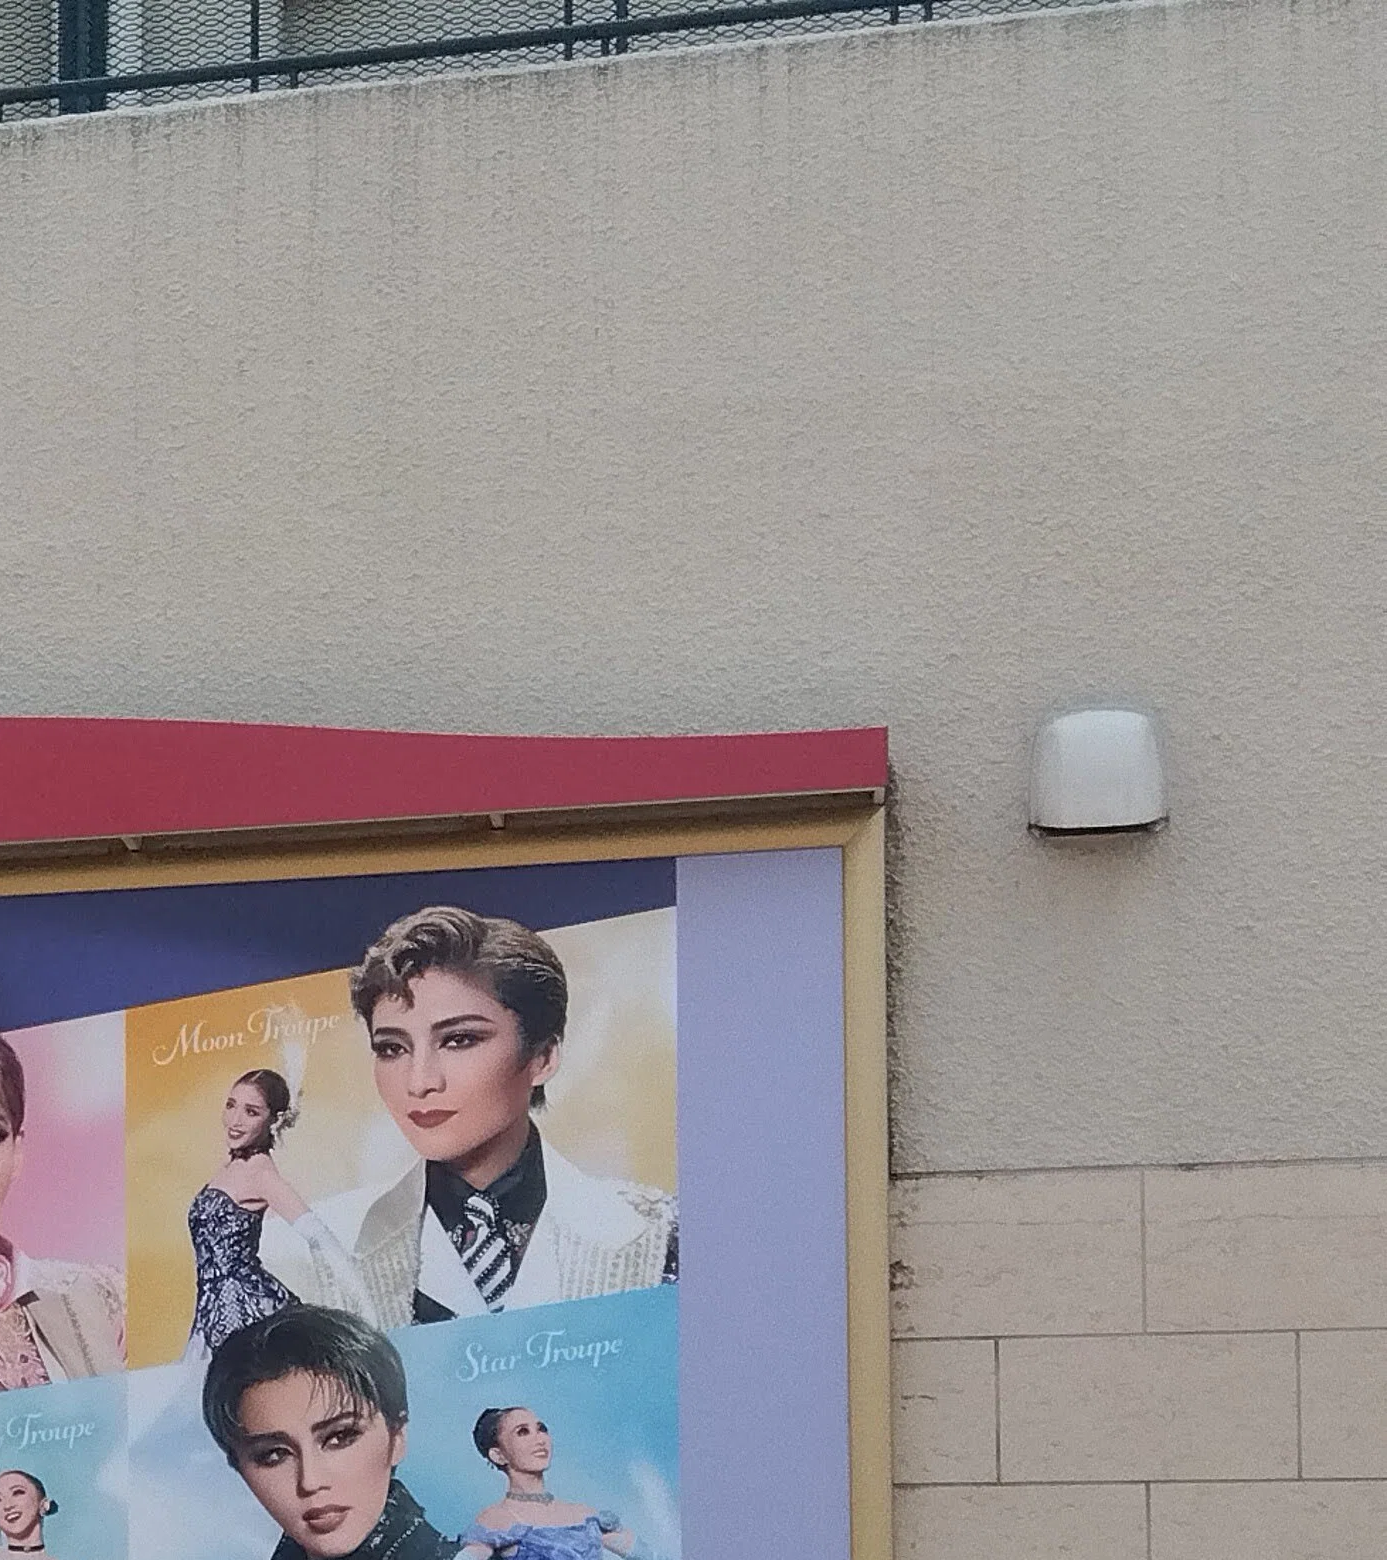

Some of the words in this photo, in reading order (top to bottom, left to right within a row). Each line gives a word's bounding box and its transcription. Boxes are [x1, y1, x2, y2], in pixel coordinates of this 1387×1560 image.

[152, 1019, 246, 1067] Moon
[247, 1003, 342, 1045] Troupe
[455, 1342, 522, 1382] Star
[526, 1328, 624, 1369] Troupe
[6, 1412, 96, 1450] Troupe
